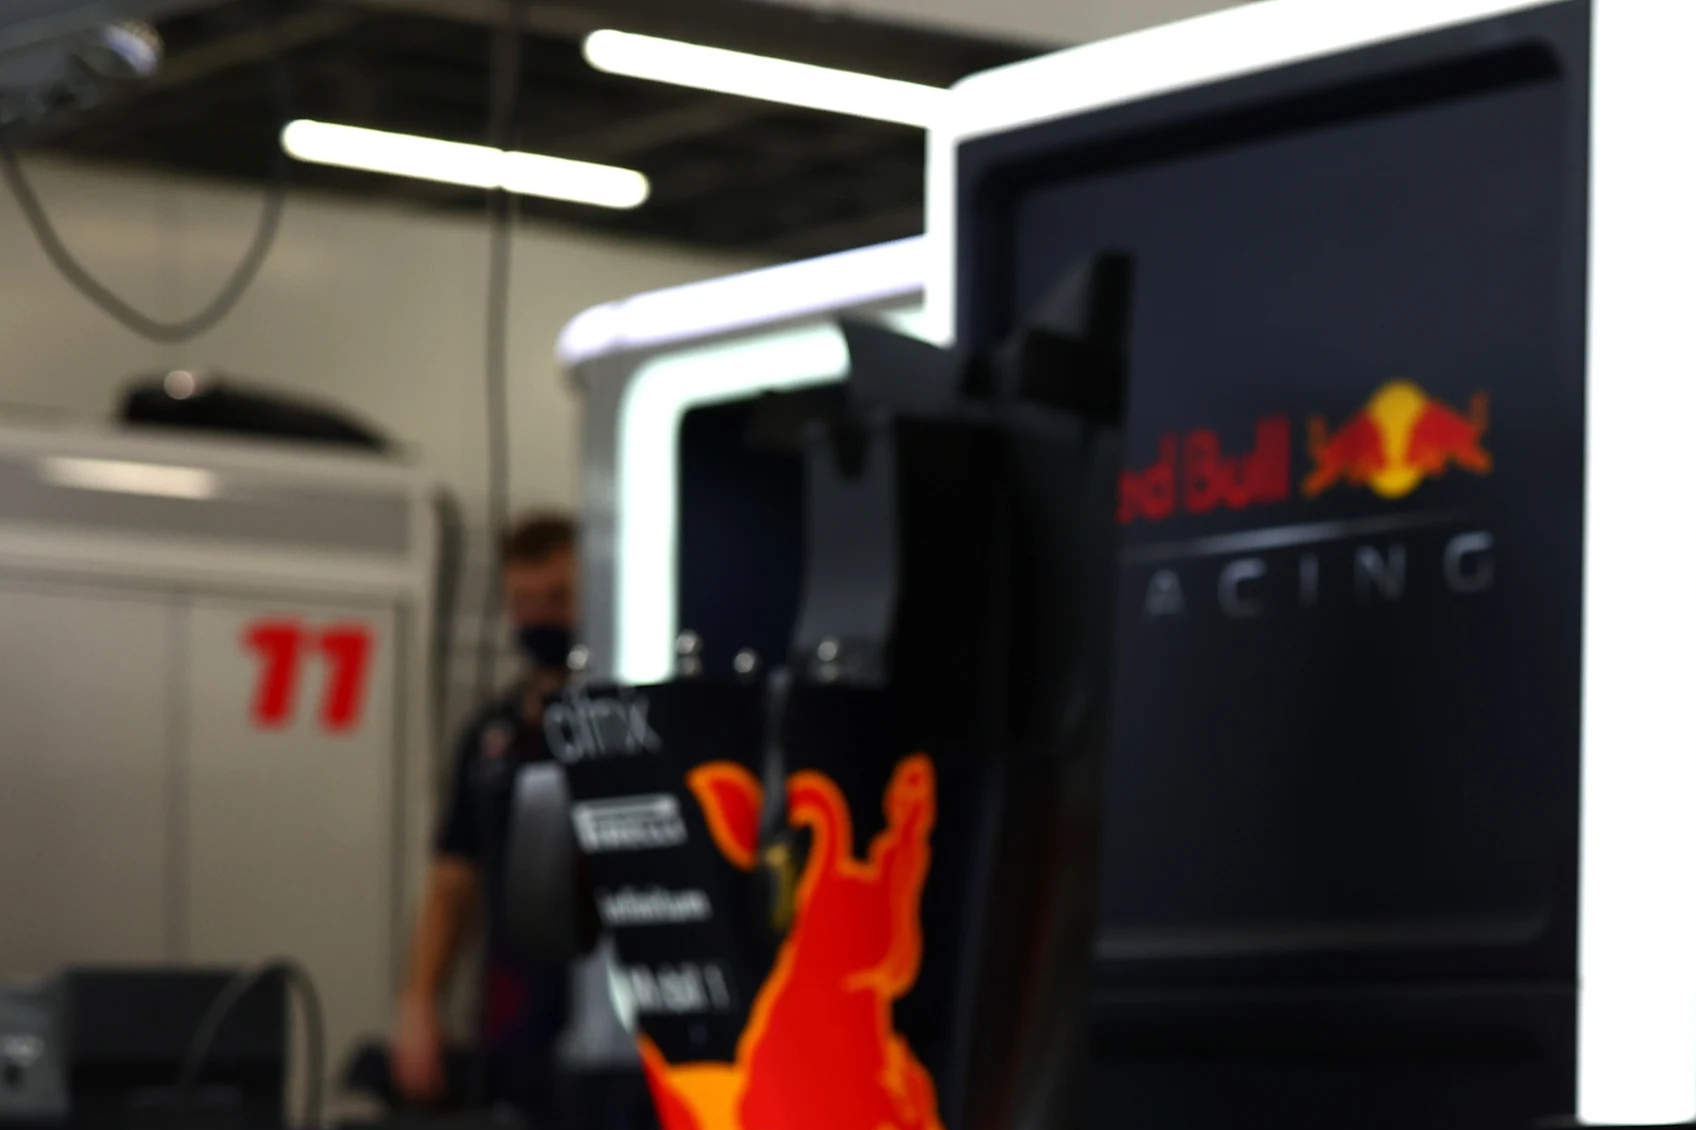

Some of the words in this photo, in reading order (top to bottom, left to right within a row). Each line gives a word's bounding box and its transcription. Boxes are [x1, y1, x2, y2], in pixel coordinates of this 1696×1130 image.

[1184, 412, 1292, 513] Bull
[1143, 528, 1495, 619] ACING
[238, 613, 377, 737] 11
